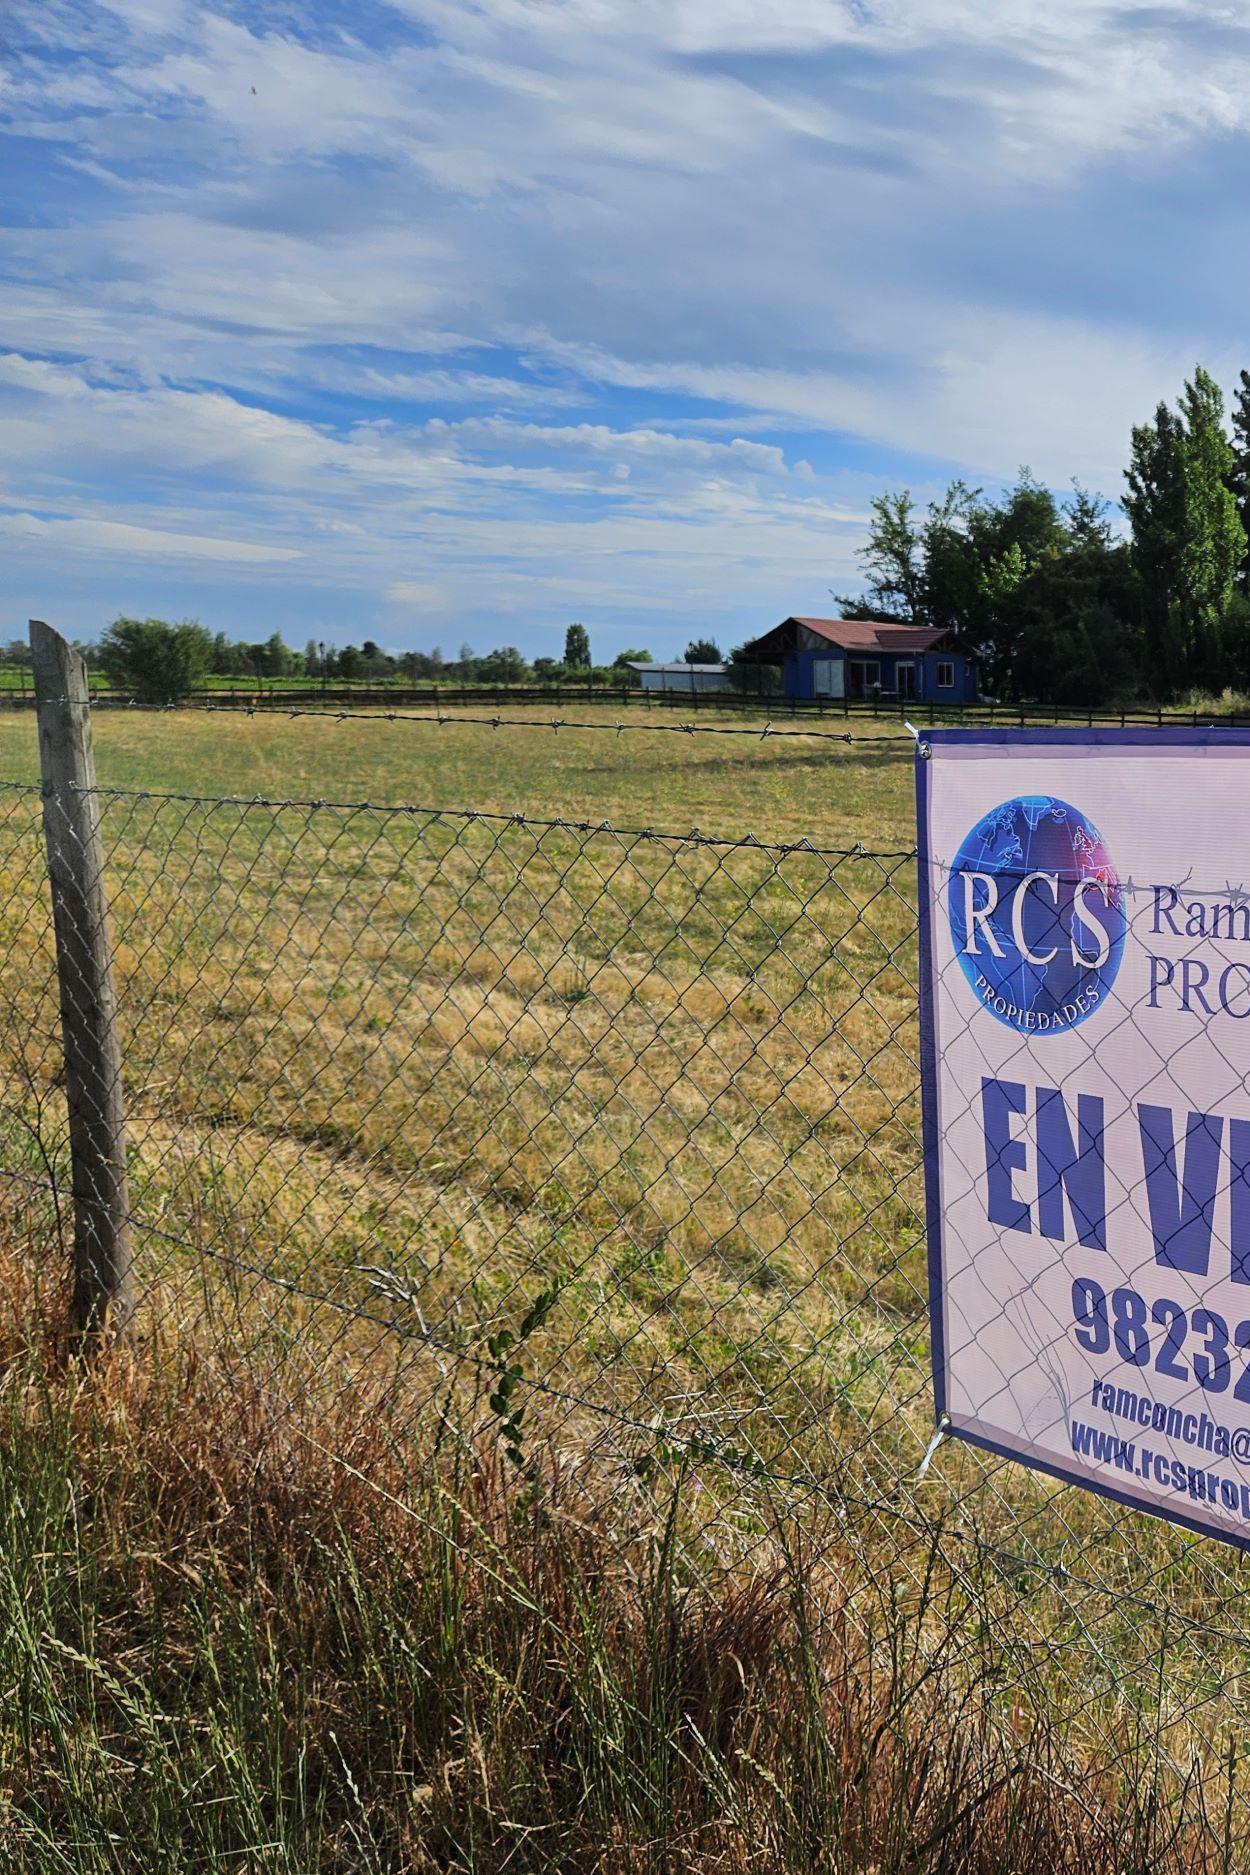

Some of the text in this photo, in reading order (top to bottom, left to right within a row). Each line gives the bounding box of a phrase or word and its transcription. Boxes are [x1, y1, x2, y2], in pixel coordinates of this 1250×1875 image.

[958, 871, 1110, 968] RCS
[976, 975, 1100, 1030] PROPIEDADES
[981, 1076, 1107, 1252] EN
